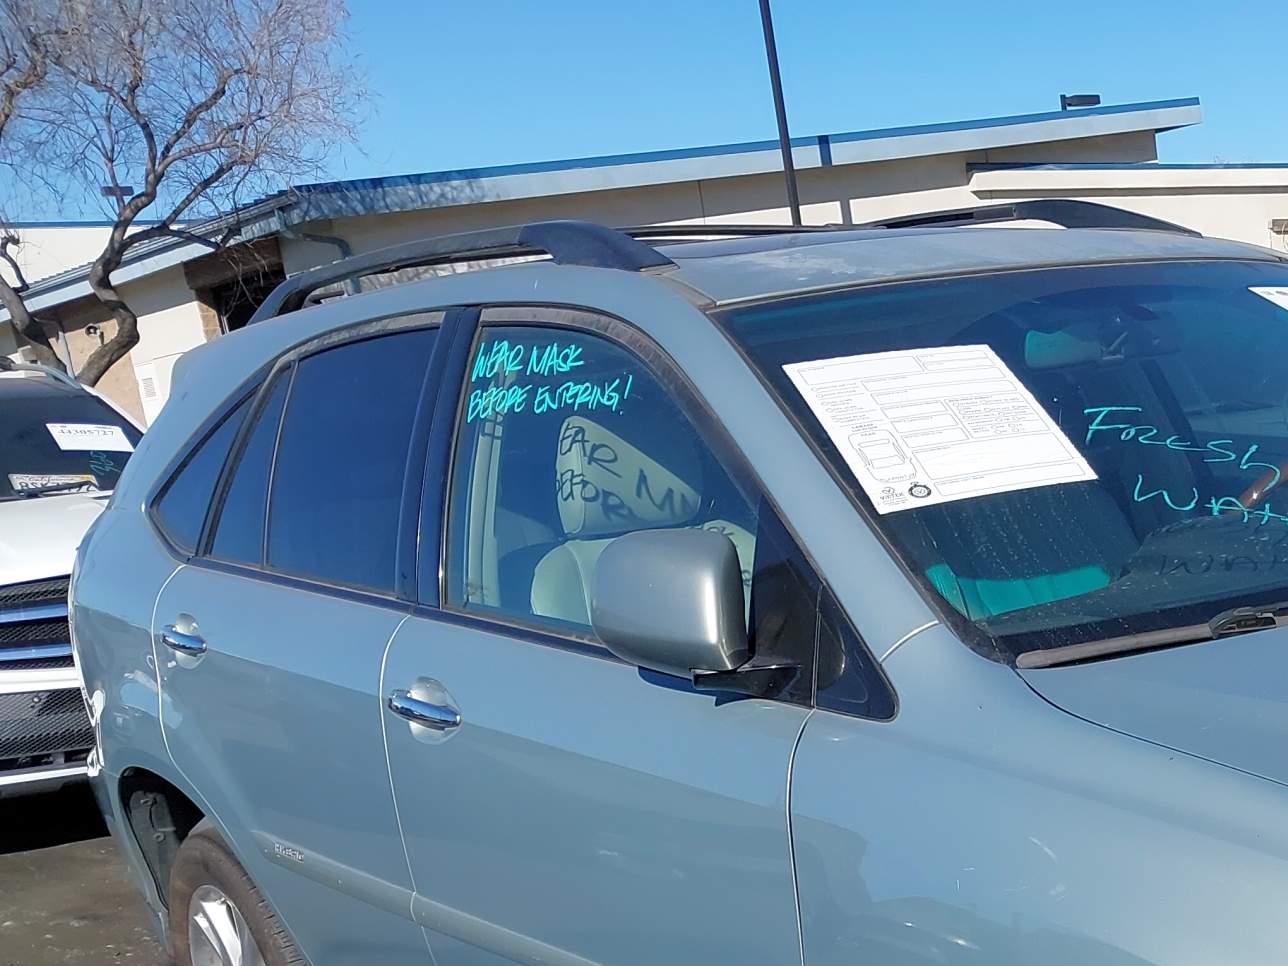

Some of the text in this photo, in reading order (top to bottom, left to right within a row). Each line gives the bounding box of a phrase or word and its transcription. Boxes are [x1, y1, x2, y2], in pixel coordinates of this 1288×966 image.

[471, 340, 585, 382] WEAR MASK
[466, 384, 533, 423] BEFORE
